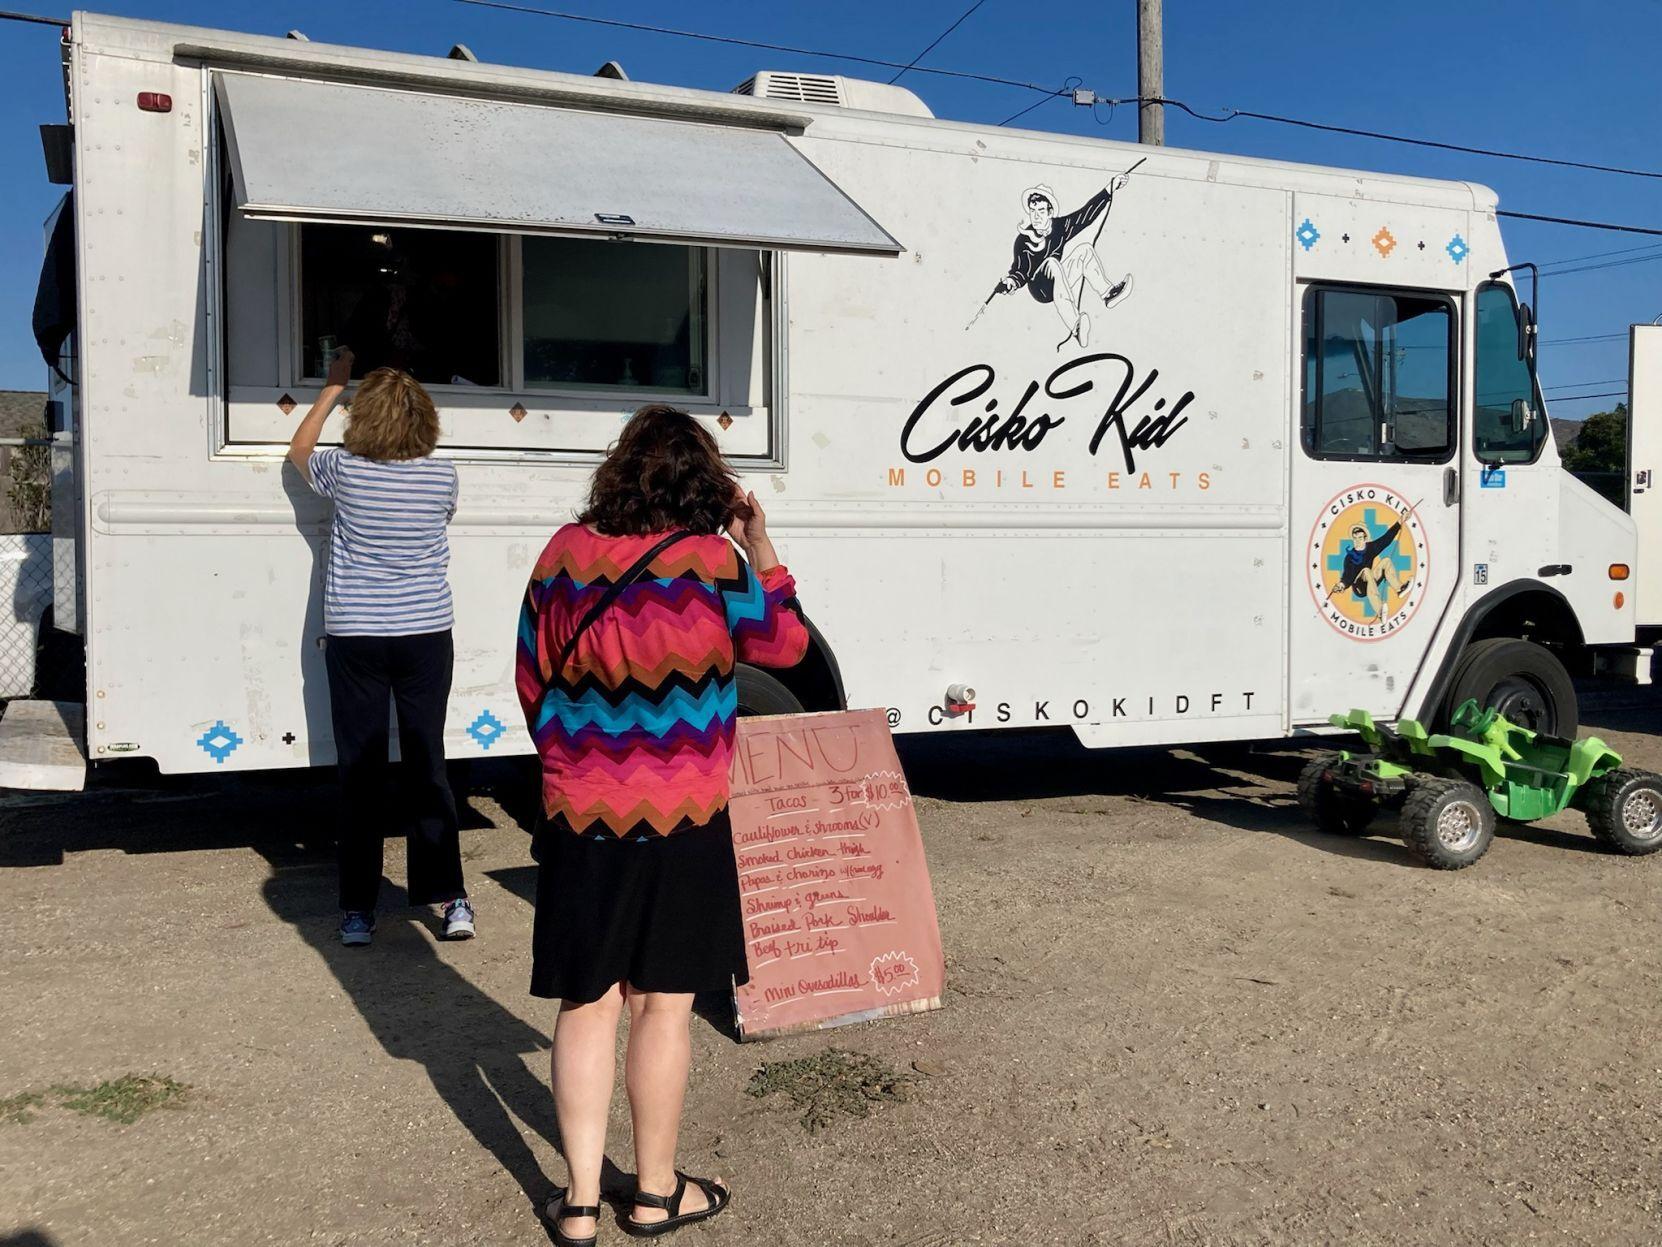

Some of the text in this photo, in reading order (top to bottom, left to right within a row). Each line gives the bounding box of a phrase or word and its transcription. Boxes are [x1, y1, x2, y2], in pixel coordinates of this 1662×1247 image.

[900, 352, 1196, 476] Cisko Kid
[888, 468, 1210, 490] MOBILE EATS
[1330, 489, 1376, 516] CISKO
[1475, 569, 1486, 583] 15
[1330, 611, 1408, 637] MOBILE EATS
[764, 795, 807, 812] Tacos
[828, 785, 845, 805] 3
